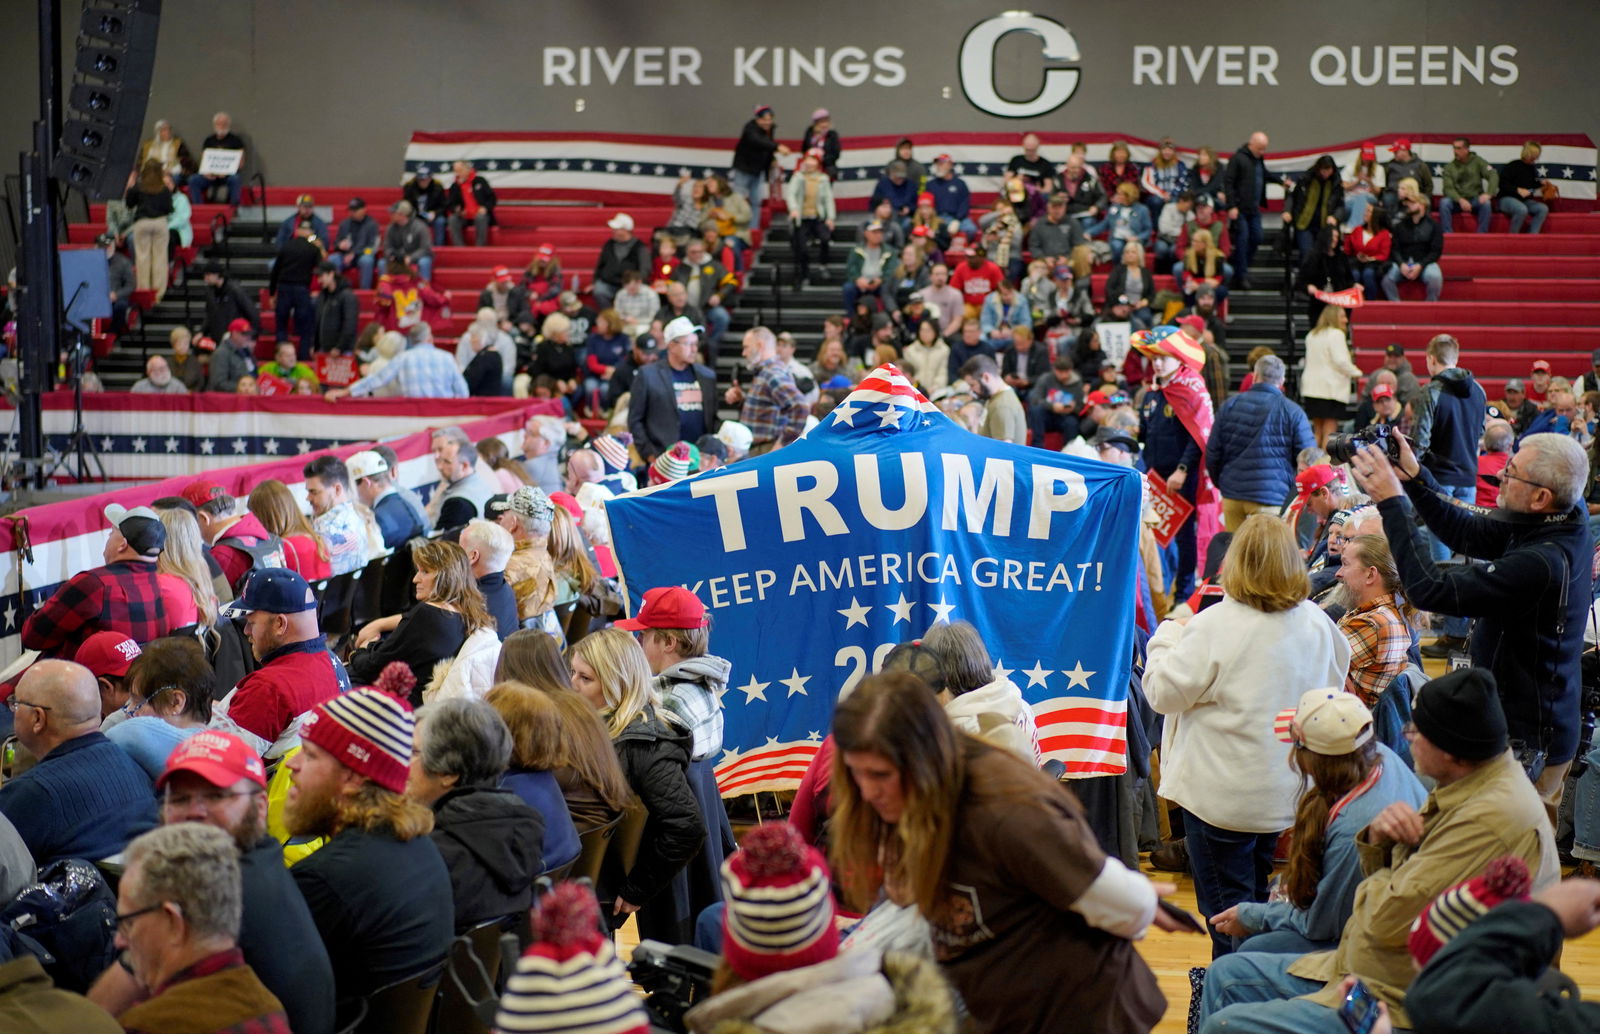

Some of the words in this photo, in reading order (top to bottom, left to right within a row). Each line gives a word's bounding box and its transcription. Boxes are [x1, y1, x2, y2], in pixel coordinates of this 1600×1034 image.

[543, 47, 702, 86] RIVER
[733, 46, 907, 87] KINGS
[1132, 45, 1279, 86] RIVER
[1309, 45, 1519, 87] QUEENS
[689, 451, 1089, 553] TRUMP
[789, 551, 961, 596] AMERICA
[971, 557, 1104, 593] GREAT!
